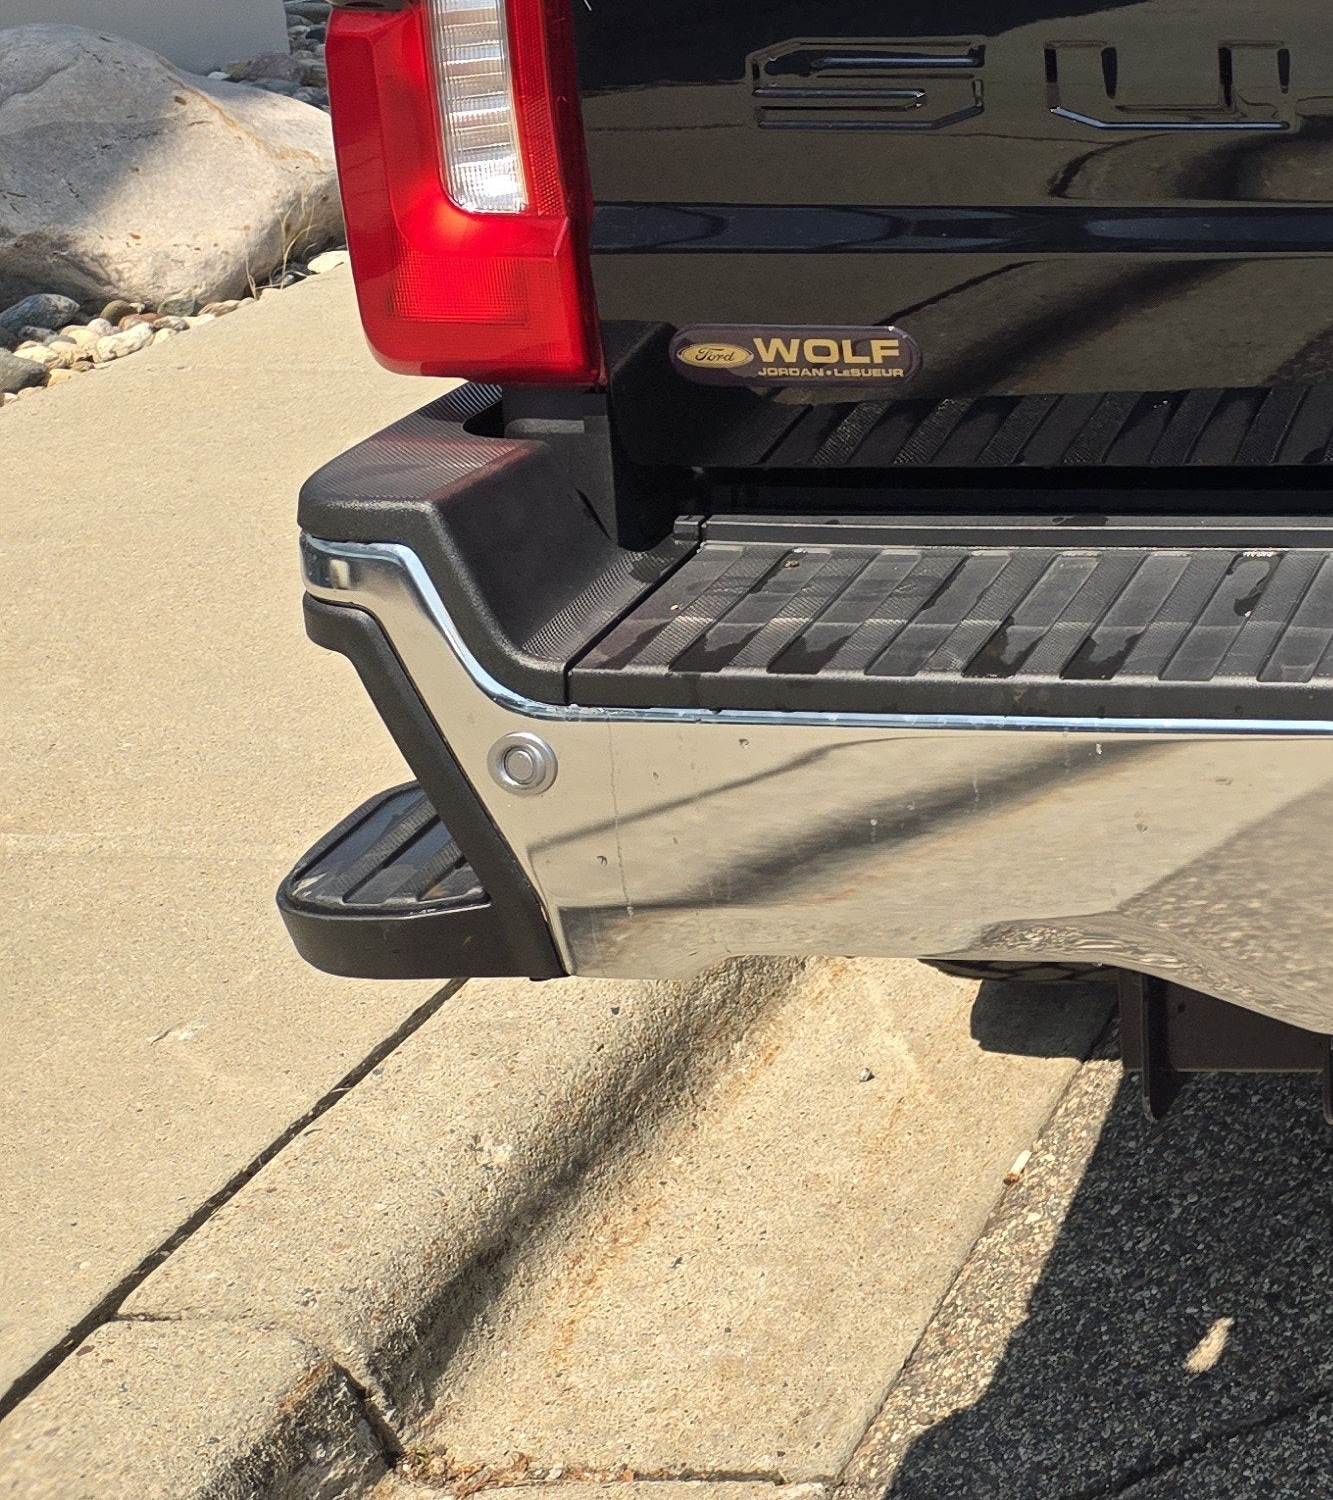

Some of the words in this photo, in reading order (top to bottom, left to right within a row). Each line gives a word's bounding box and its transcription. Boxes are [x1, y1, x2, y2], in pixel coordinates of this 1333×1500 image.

[694, 346, 736, 363] Ford
[753, 337, 900, 364] WOLF
[757, 366, 824, 377] JORDAN
